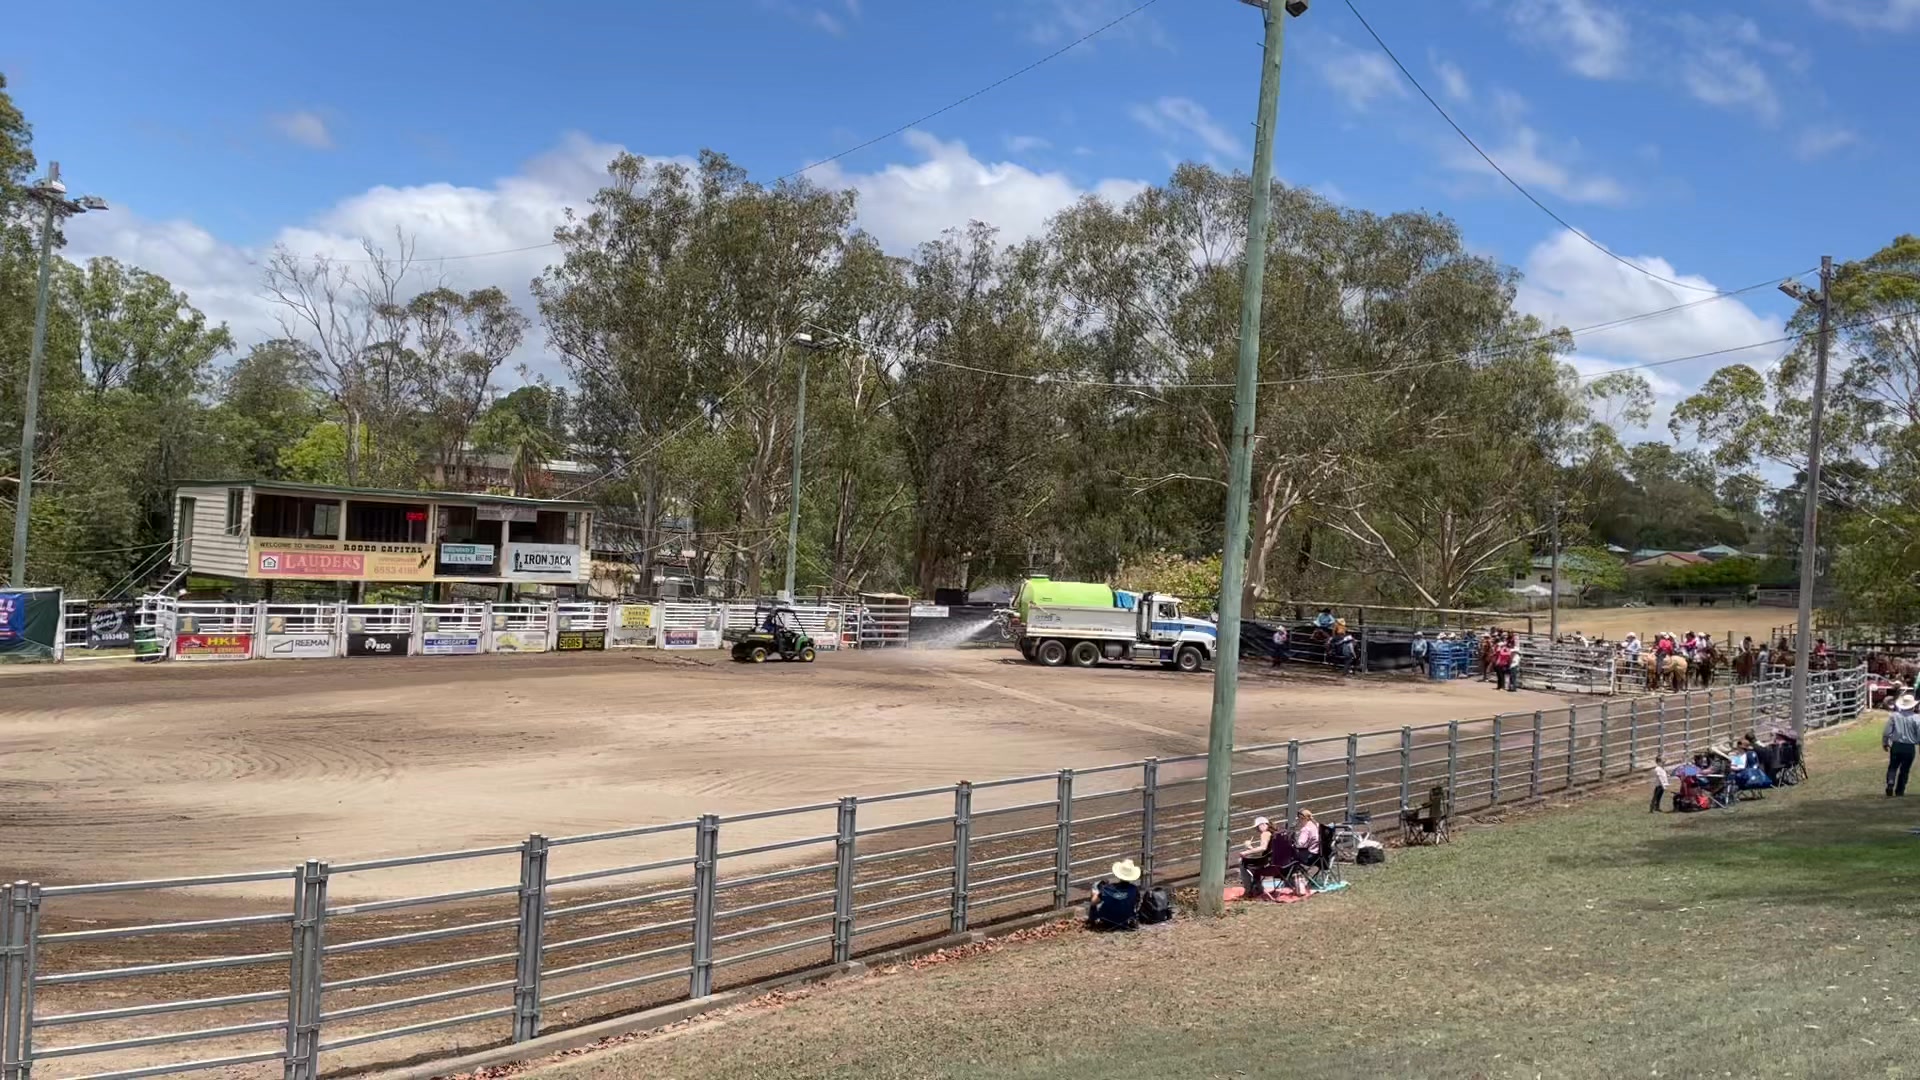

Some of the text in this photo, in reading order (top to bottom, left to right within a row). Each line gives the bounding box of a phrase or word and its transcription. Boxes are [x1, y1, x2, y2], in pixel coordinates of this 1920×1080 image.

[343, 544, 376, 552] RODEO
[286, 555, 360, 570] LAUDERS
[524, 554, 572, 566] IRON JACK
[180, 617, 194, 632] 1
[267, 617, 284, 632] 2
[350, 617, 362, 631] 3
[425, 617, 438, 630] 4
[707, 616, 718, 628] 7
[826, 619, 837, 631] 9
[207, 637, 240, 646] HKL
